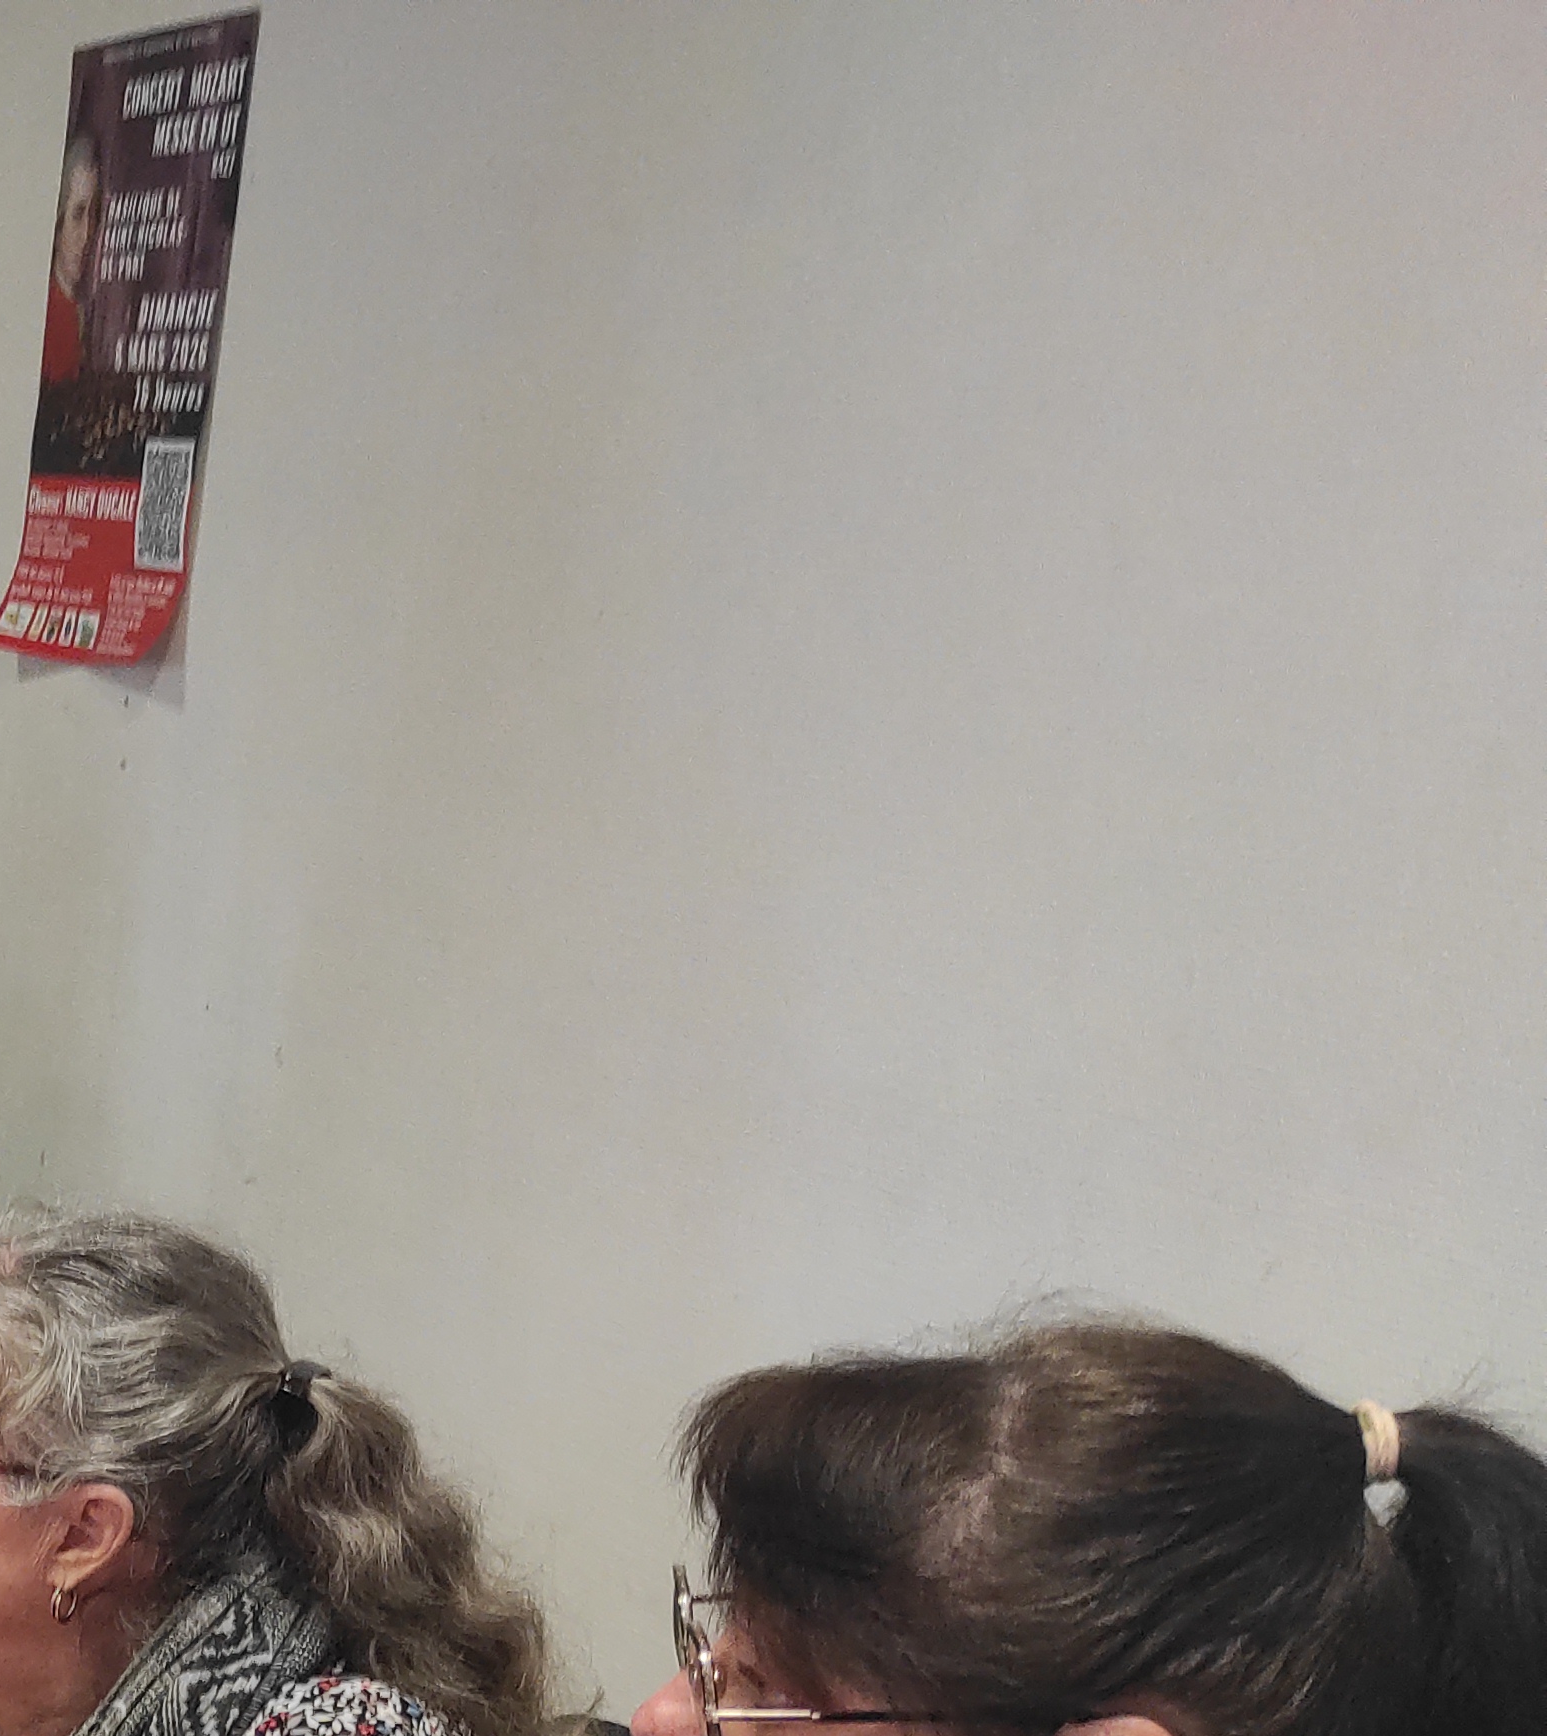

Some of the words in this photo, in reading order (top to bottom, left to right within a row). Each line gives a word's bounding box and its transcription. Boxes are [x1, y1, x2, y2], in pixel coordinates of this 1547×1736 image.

[123, 66, 184, 120] CONCERT
[189, 55, 248, 106] MOZART
[221, 103, 242, 148] UT
[137, 287, 219, 332] DIMANCHE
[127, 332, 168, 373] MARS
[169, 332, 207, 372] 2026
